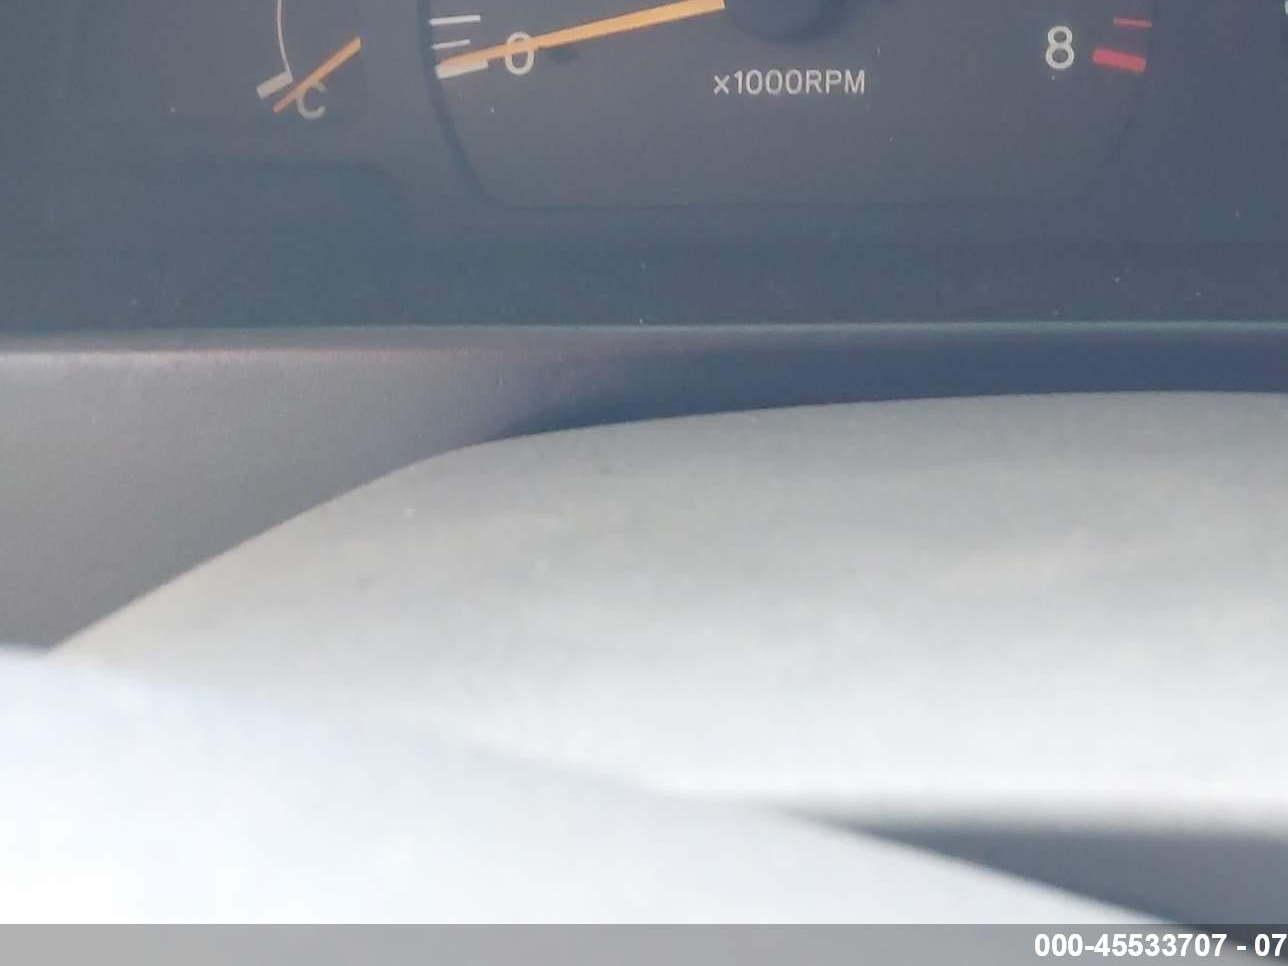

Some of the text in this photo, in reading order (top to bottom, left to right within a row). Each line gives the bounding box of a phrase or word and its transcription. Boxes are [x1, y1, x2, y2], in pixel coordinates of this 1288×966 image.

[504, 32, 535, 75] 0
[1045, 26, 1074, 69] 8
[296, 82, 327, 120] C
[714, 69, 864, 94] x1000RPM
